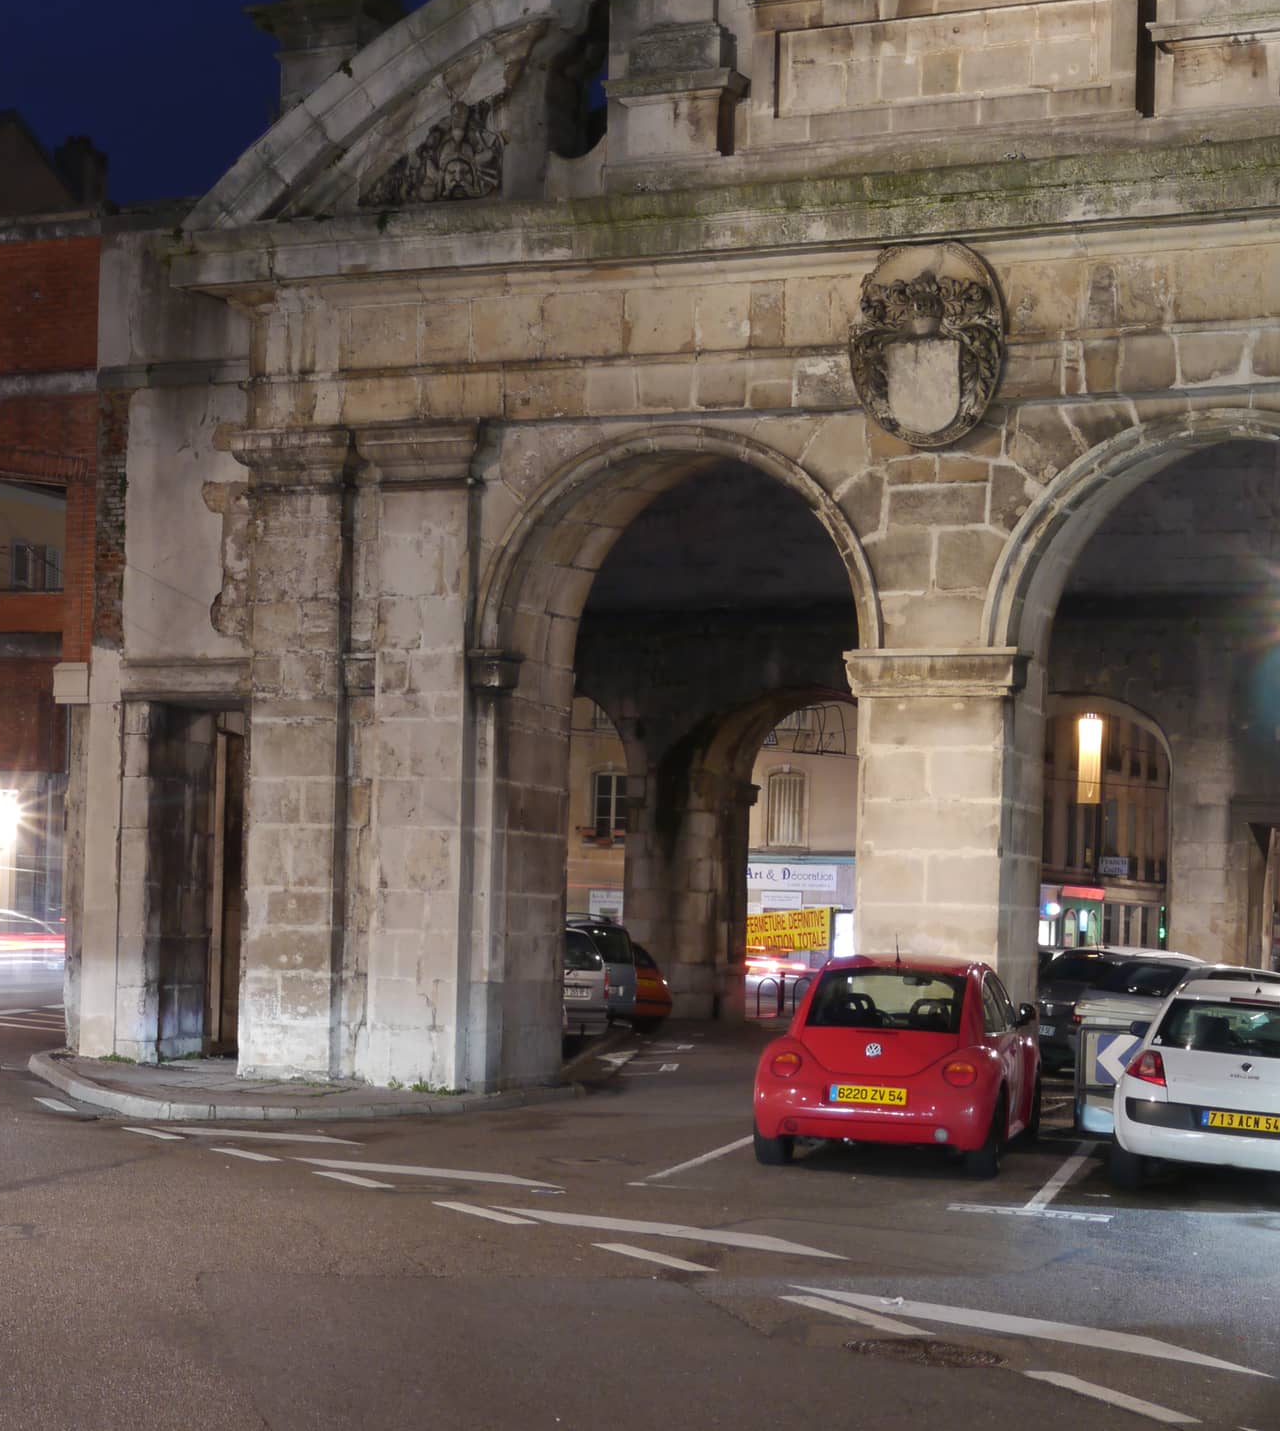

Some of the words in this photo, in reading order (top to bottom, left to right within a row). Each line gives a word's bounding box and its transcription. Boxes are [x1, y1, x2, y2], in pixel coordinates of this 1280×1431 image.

[798, 930, 827, 949] TOTALE
[838, 1088, 868, 1100] 6220
[871, 1090, 886, 1101] ZV
[888, 1091, 903, 1102] 54
[1210, 1113, 1234, 1126] 713
[1238, 1115, 1260, 1129] ACN
[1265, 1118, 1279, 1131] 54
